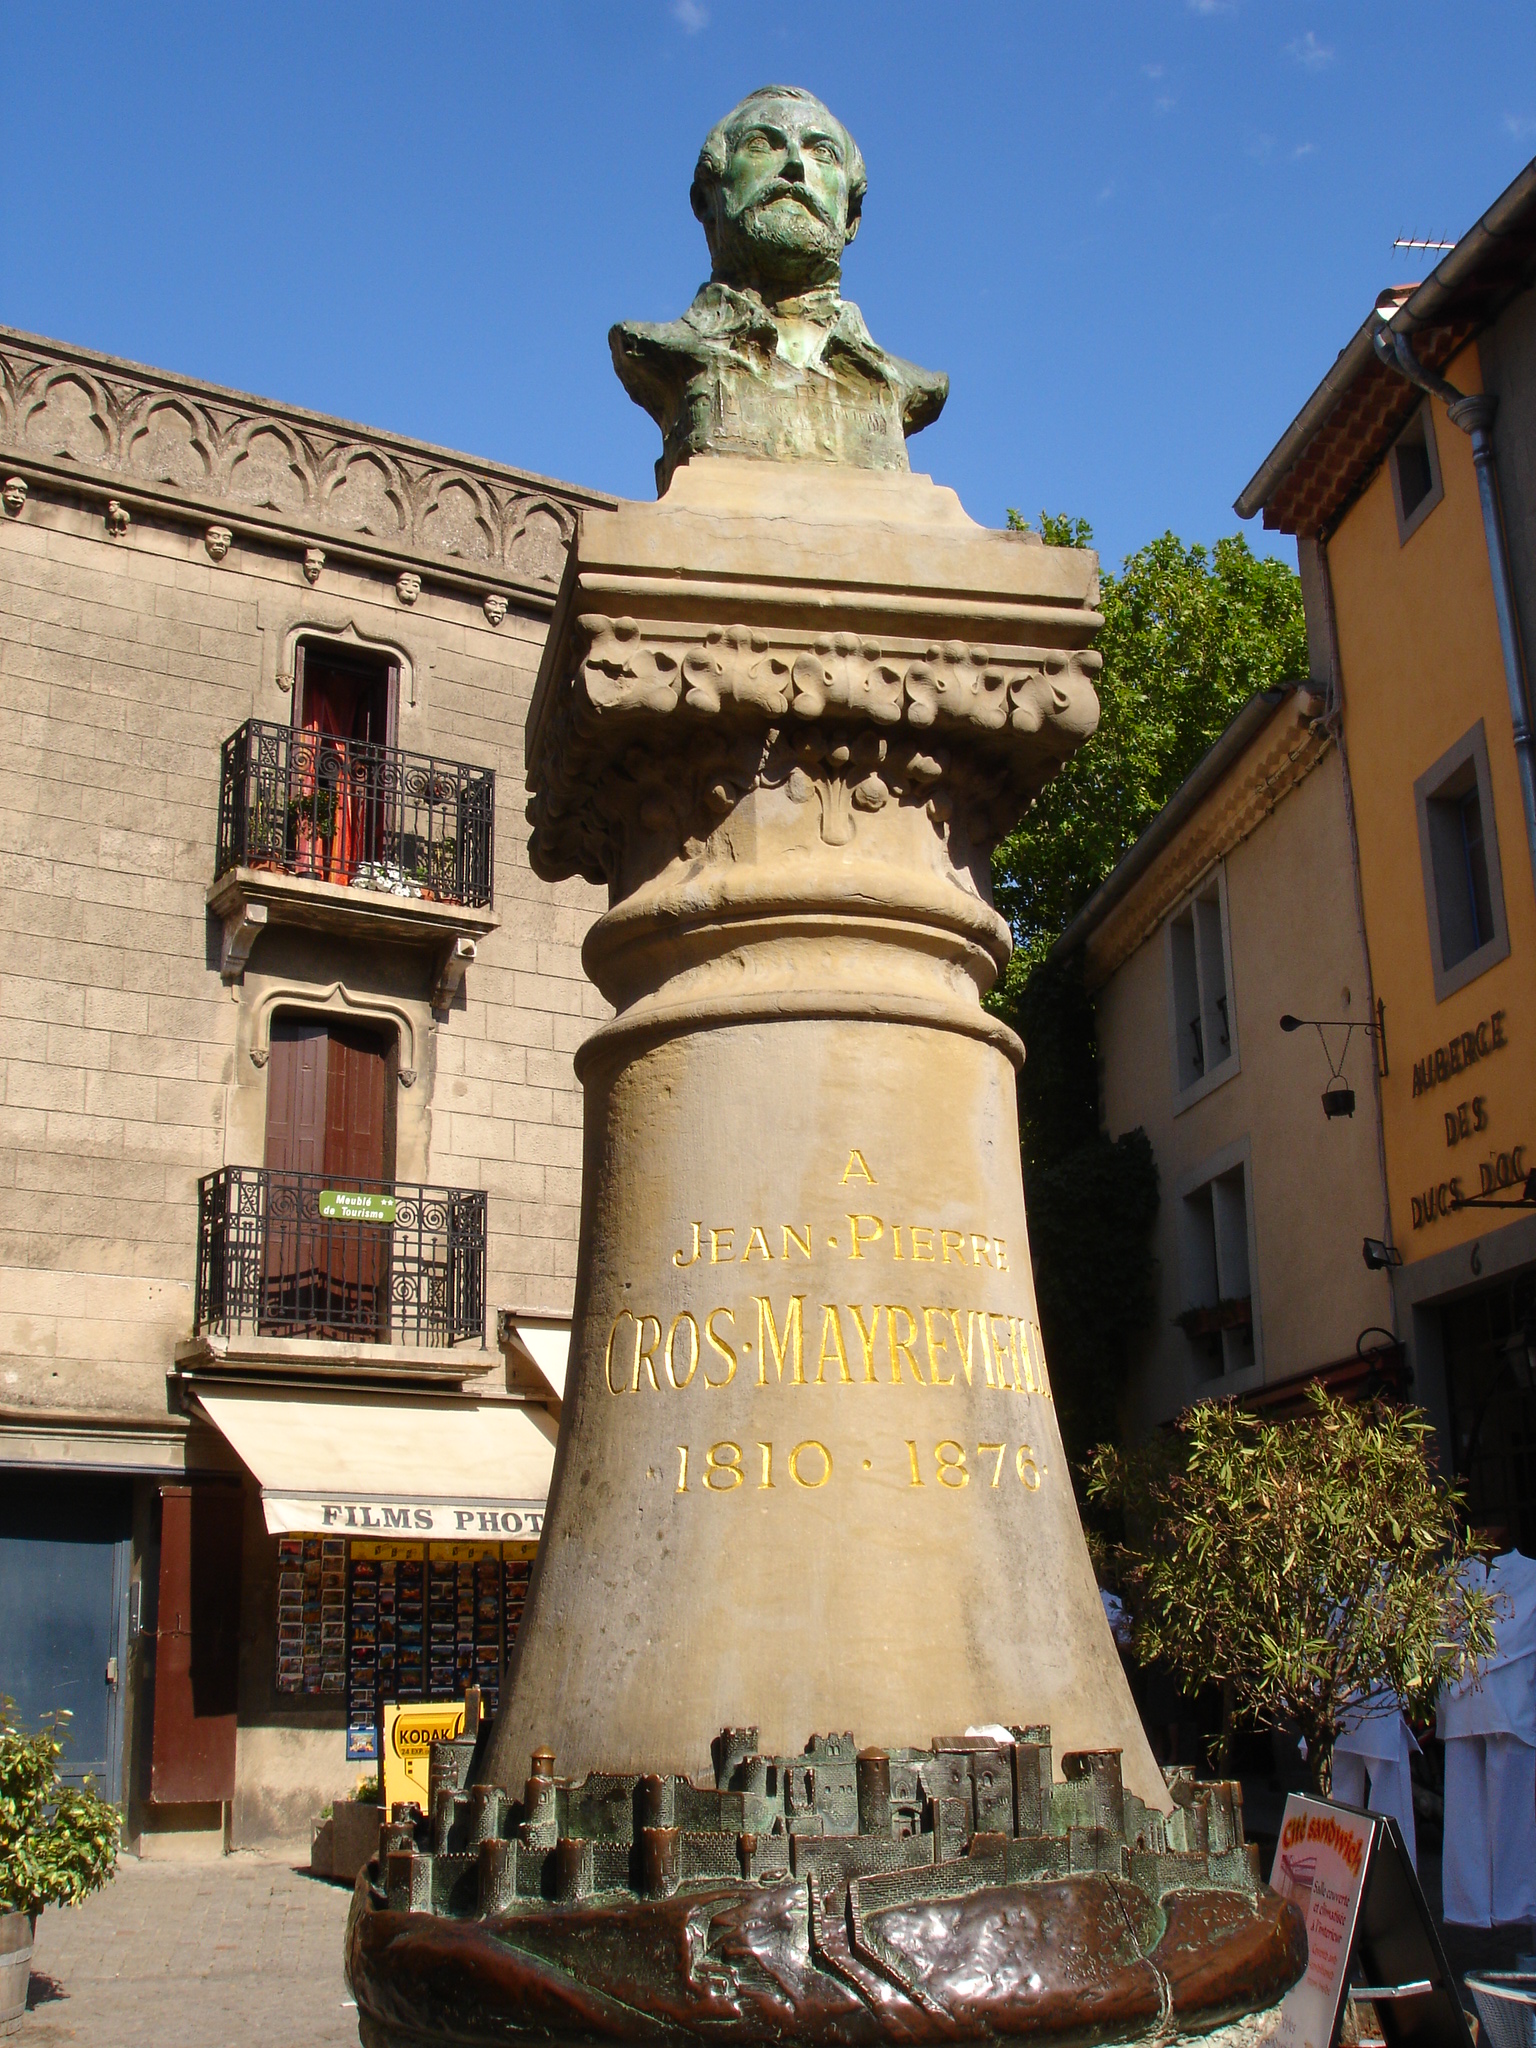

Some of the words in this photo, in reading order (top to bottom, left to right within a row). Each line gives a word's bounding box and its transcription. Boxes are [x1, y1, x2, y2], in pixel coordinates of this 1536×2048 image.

[1412, 1010, 1507, 1098] AUBERGE
[1445, 1096, 1487, 1147] DES
[838, 1149, 877, 1185] A
[323, 1206, 335, 1215] de
[341, 1207, 384, 1218] Tourisme
[336, 1195, 372, 1206] Meublé
[675, 1440, 834, 1494] 1810
[321, 1504, 434, 1530] FILMS
[453, 1510, 543, 1533] PHOT
[400, 1728, 450, 1746] KODAK
